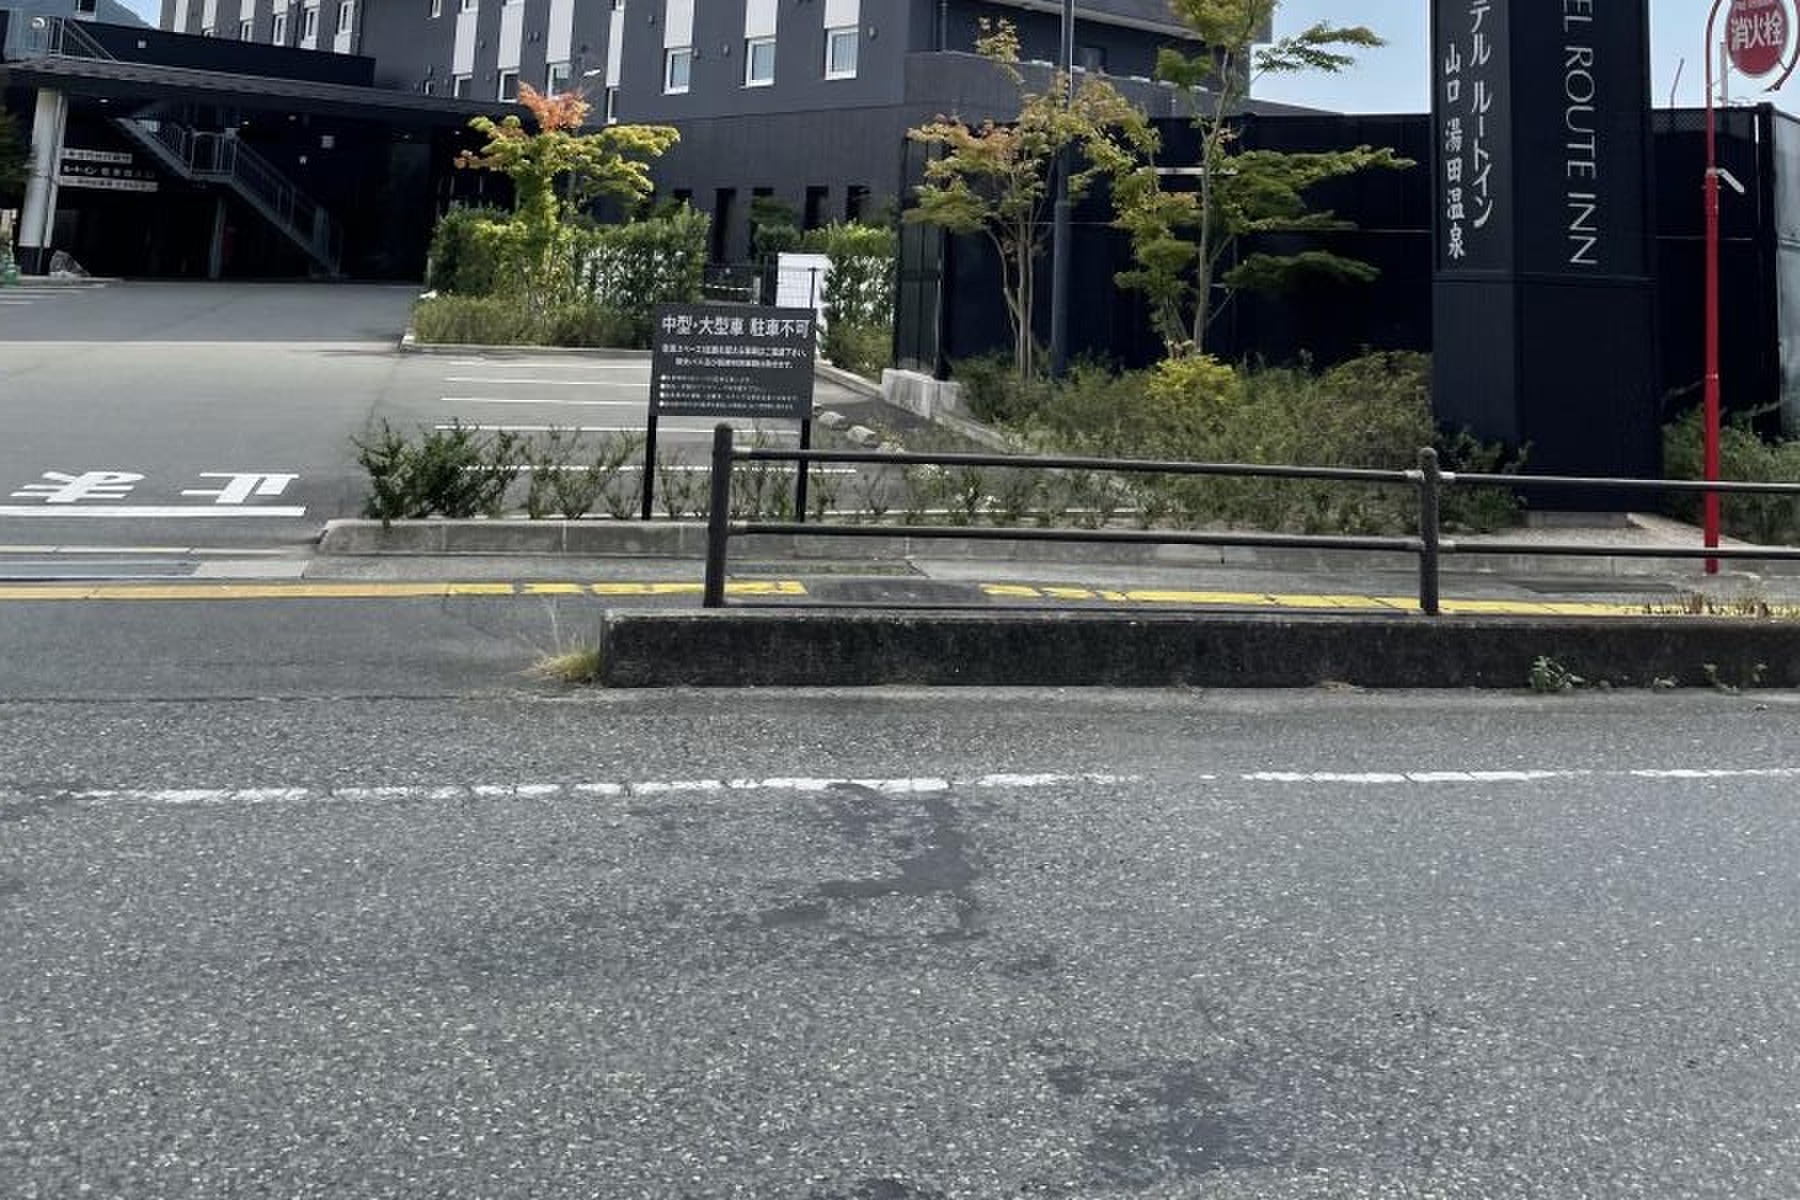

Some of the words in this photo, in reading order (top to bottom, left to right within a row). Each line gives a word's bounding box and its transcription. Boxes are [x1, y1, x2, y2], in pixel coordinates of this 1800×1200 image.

[1446, 42, 1461, 104] 山口
[1730, 10, 1783, 50] 消火栓
[1472, 80, 1492, 228] ルートイン
[1564, 47, 1596, 177] ROUTE
[1446, 117, 1465, 260] 湯田温泉
[1567, 193, 1598, 265] INN
